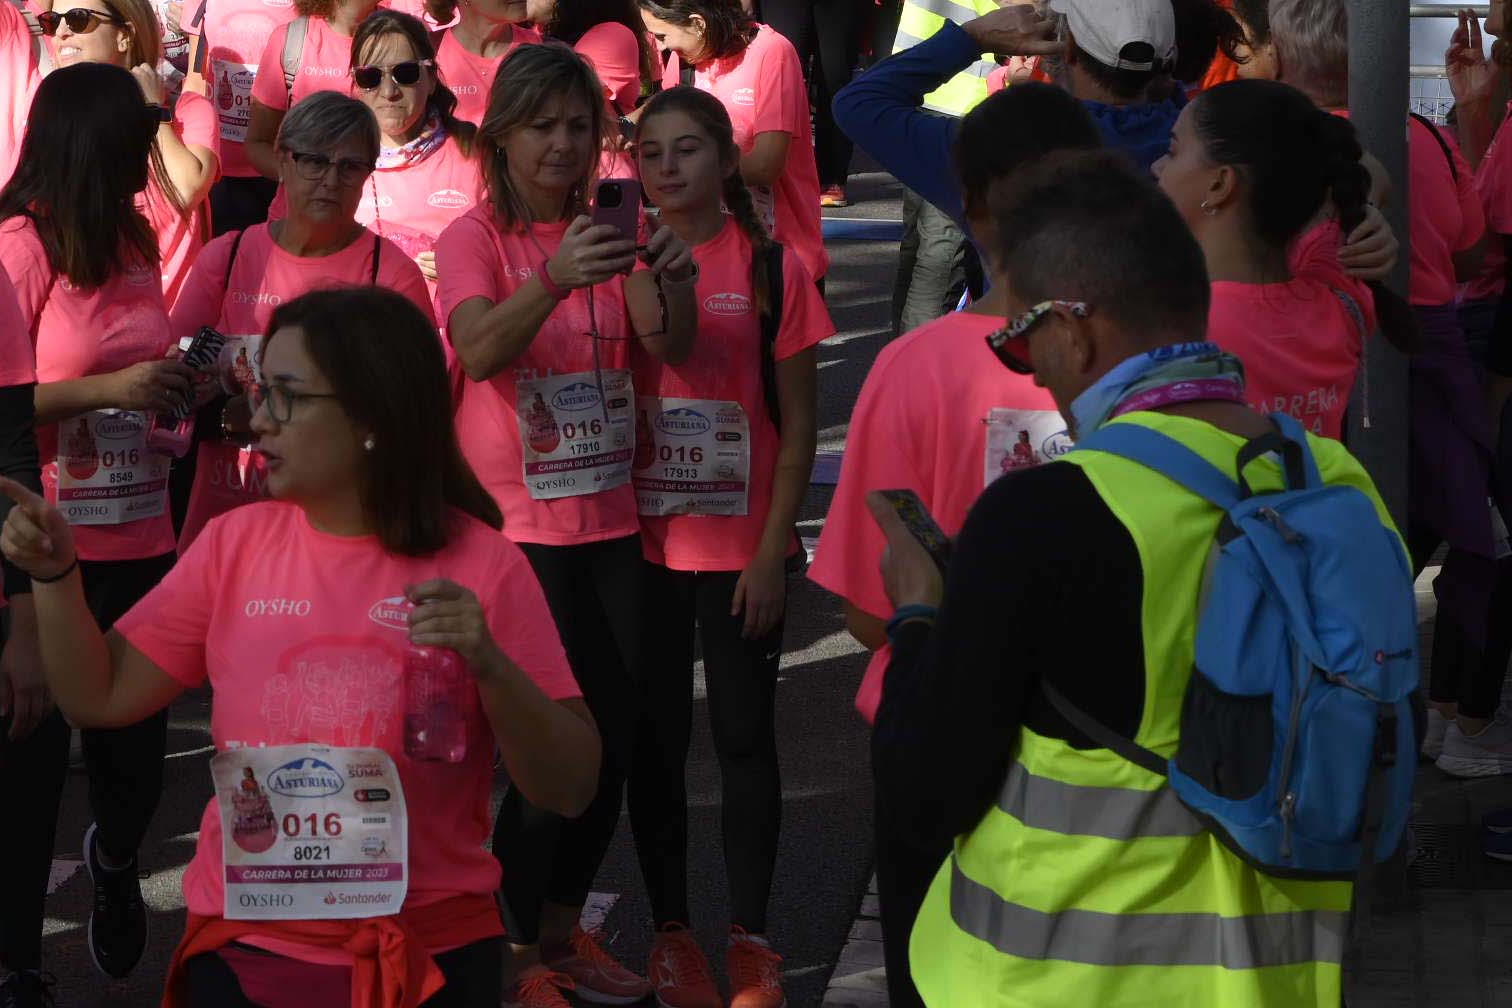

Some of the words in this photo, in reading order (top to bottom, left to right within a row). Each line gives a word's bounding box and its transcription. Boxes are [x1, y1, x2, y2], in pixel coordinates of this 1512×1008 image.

[707, 300, 749, 310] ASTURIANA
[554, 392, 602, 408] ASTURIANA
[562, 419, 602, 439] 016
[660, 416, 707, 430] ASTURIANA
[570, 441, 600, 455] 17910
[659, 445, 703, 463] 016
[102, 448, 139, 468] 016
[538, 459, 574, 472] CARRERA
[574, 458, 584, 467] DE
[109, 471, 133, 484] 8549
[663, 467, 698, 479] 17913
[536, 477, 576, 491] OYSHO
[666, 482, 677, 491] DE
[678, 482, 688, 491] LA
[68, 506, 108, 518] OYSHO
[245, 599, 312, 618] OYSHO
[348, 769, 384, 778] SUMA
[274, 776, 339, 790] ASTURIANA
[282, 812, 343, 837] 016
[294, 845, 331, 861] 8021
[242, 869, 292, 880] CARRERA
[295, 870, 309, 880] DE
[311, 870, 324, 879] LA
[326, 869, 363, 879] MUJER
[239, 893, 294, 908] OYSHO
[337, 892, 392, 906] Santander
